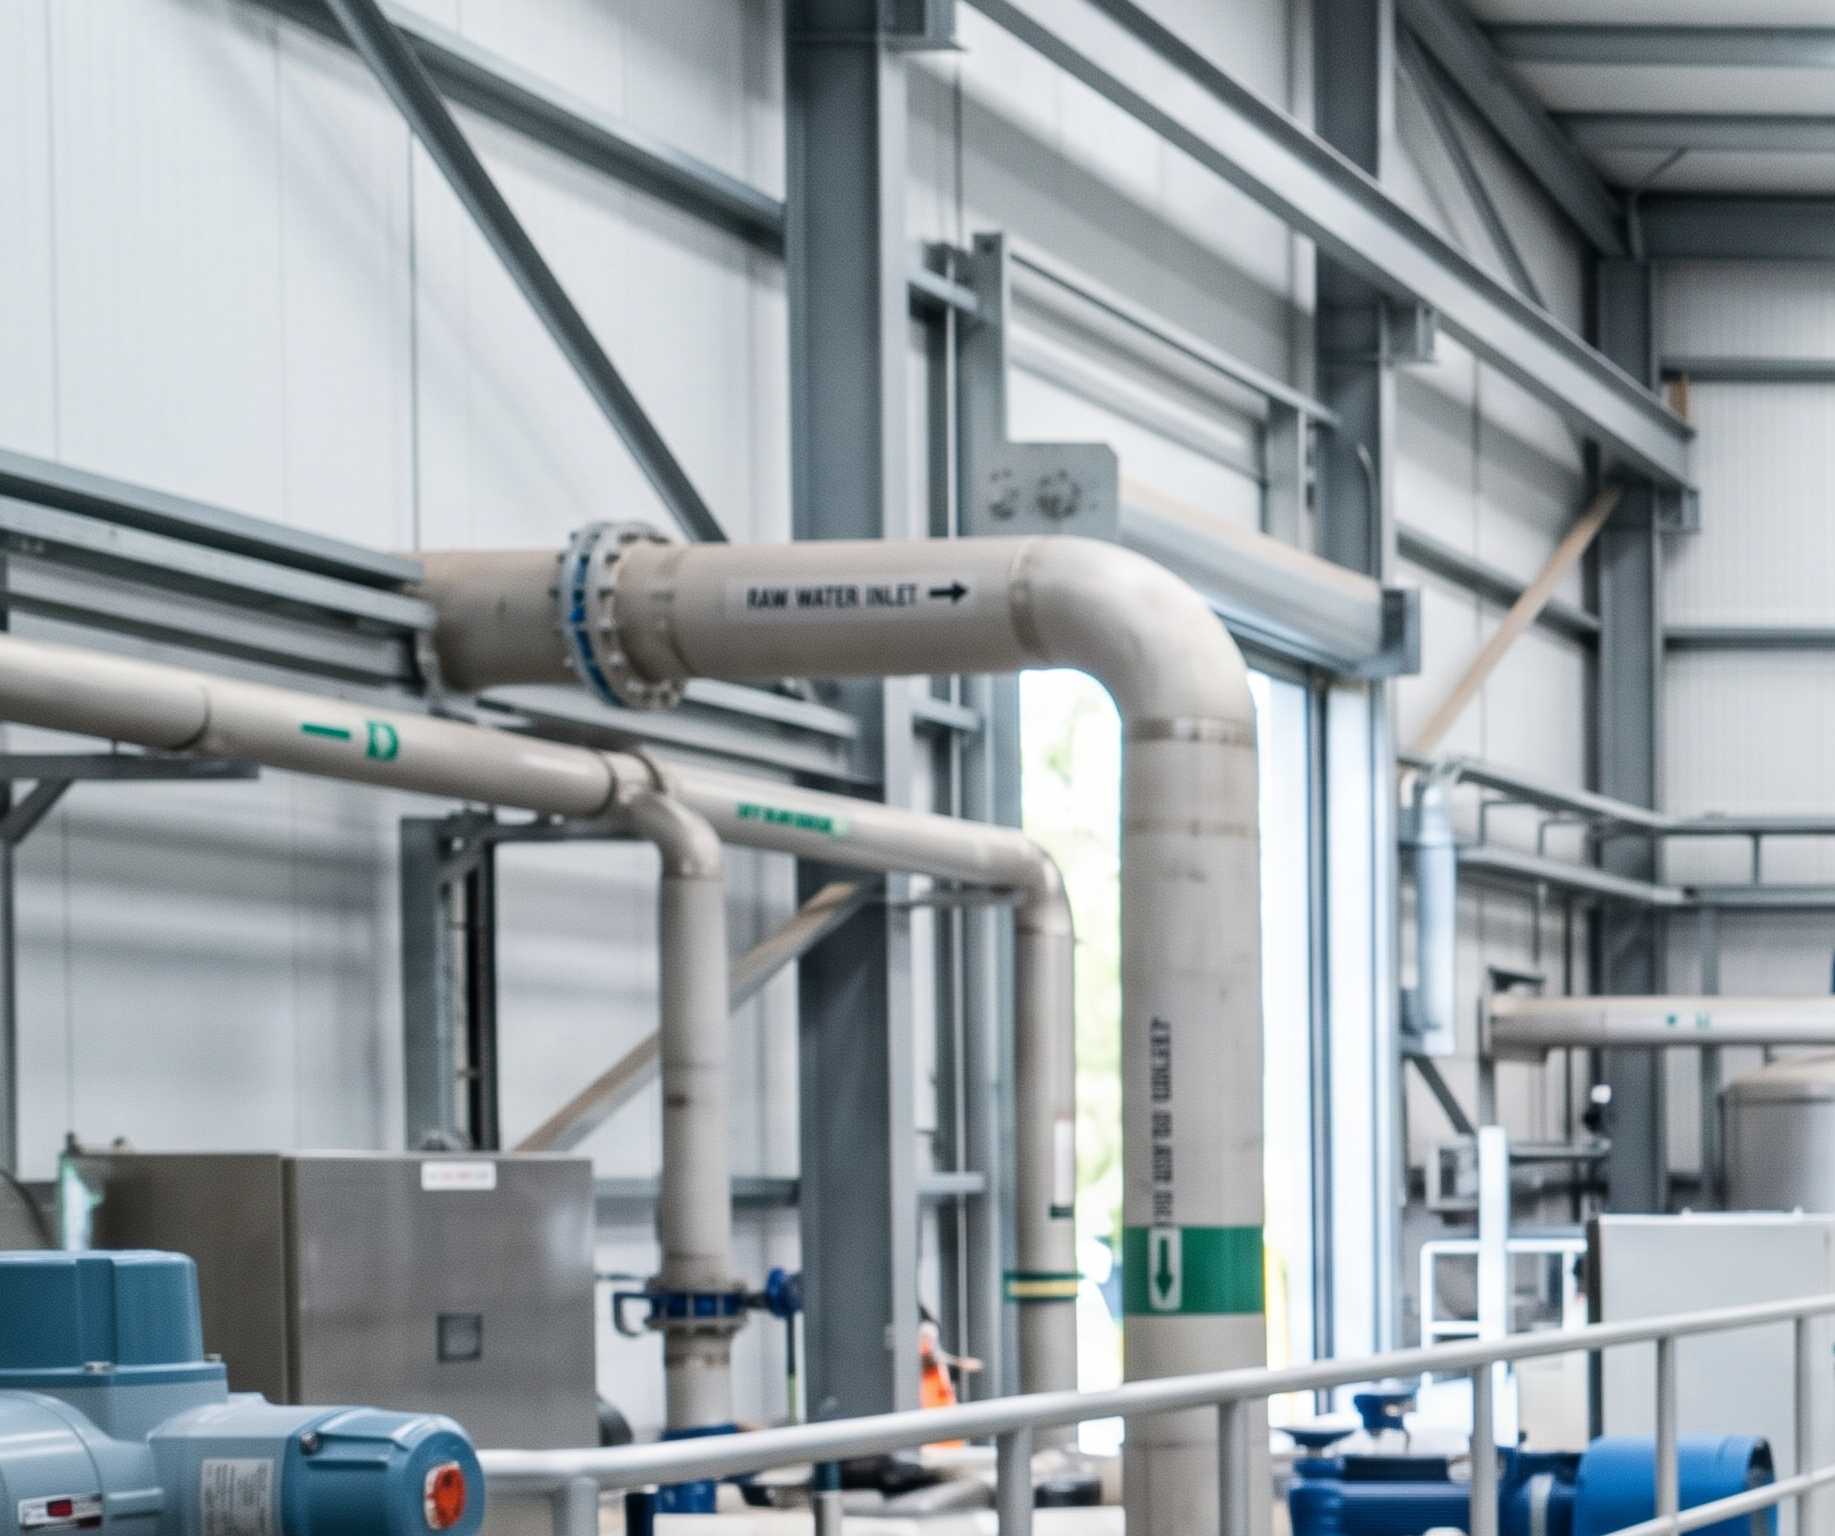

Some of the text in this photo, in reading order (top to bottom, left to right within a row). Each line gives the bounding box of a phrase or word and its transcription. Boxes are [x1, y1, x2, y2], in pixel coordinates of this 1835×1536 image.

[747, 582, 917, 608] RAW WATER INLET
